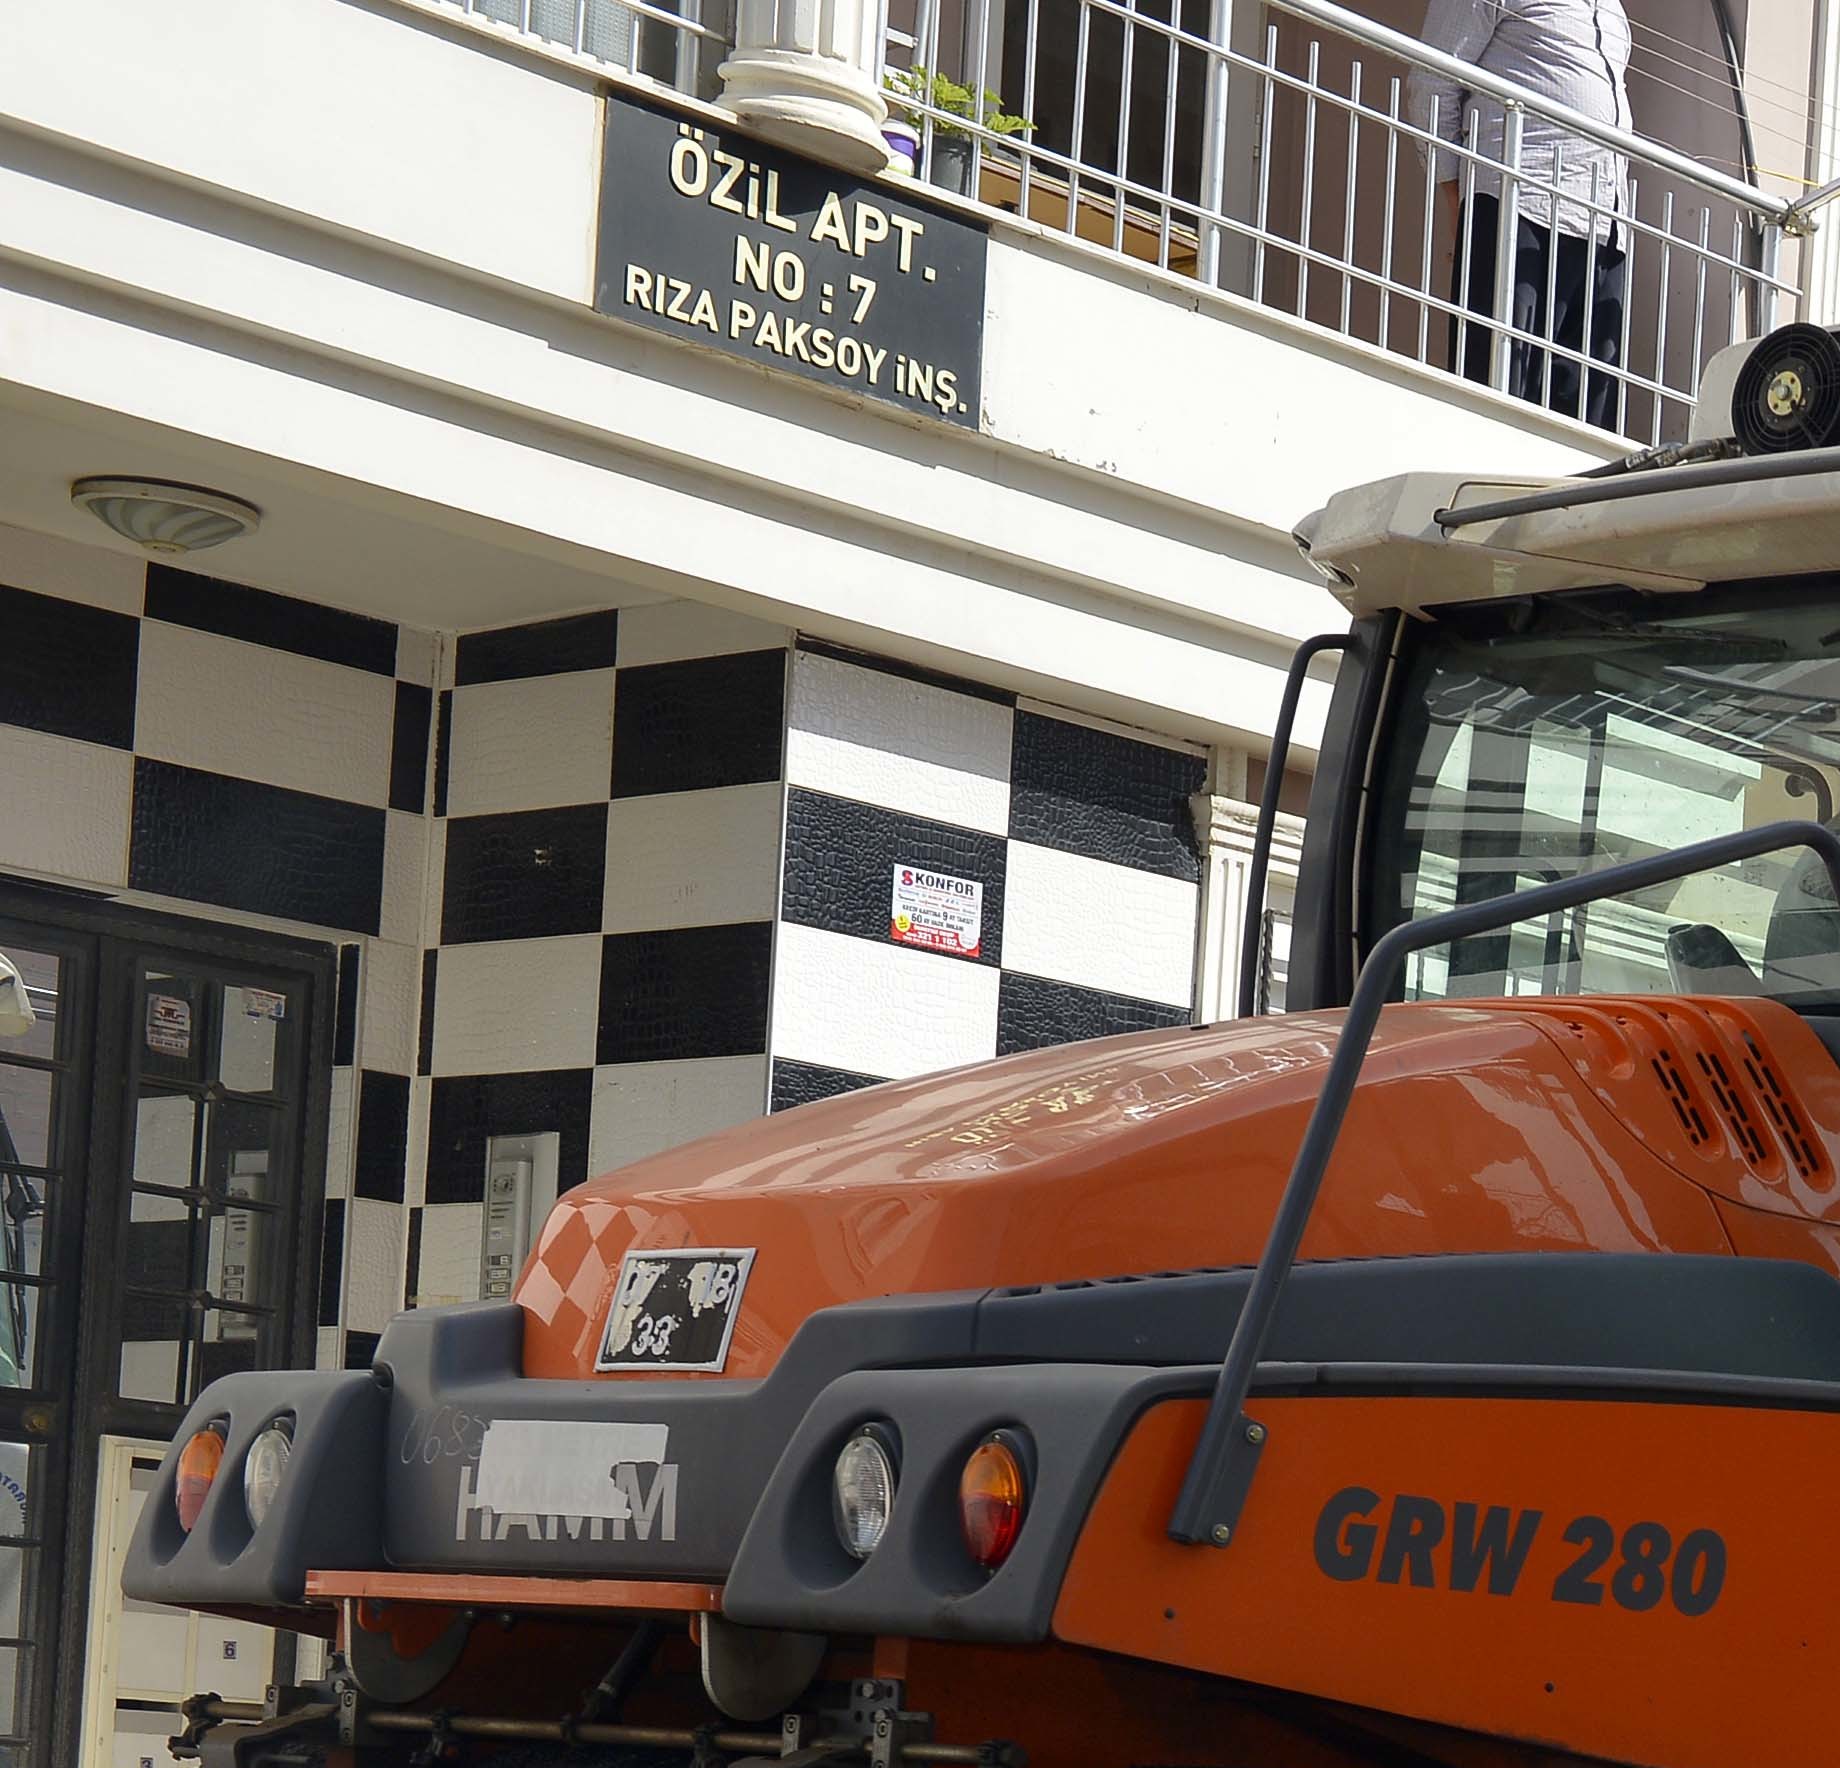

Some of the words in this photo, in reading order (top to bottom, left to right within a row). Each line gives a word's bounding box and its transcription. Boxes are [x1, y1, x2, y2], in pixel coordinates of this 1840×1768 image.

[733, 233, 806, 303] NO
[848, 274, 878, 325] 7
[810, 191, 937, 283] APT.
[624, 262, 720, 334] RIZA
[729, 299, 888, 386] PAKSOY
[1313, 1485, 1543, 1597] GRW
[1551, 1514, 1727, 1617] 280
